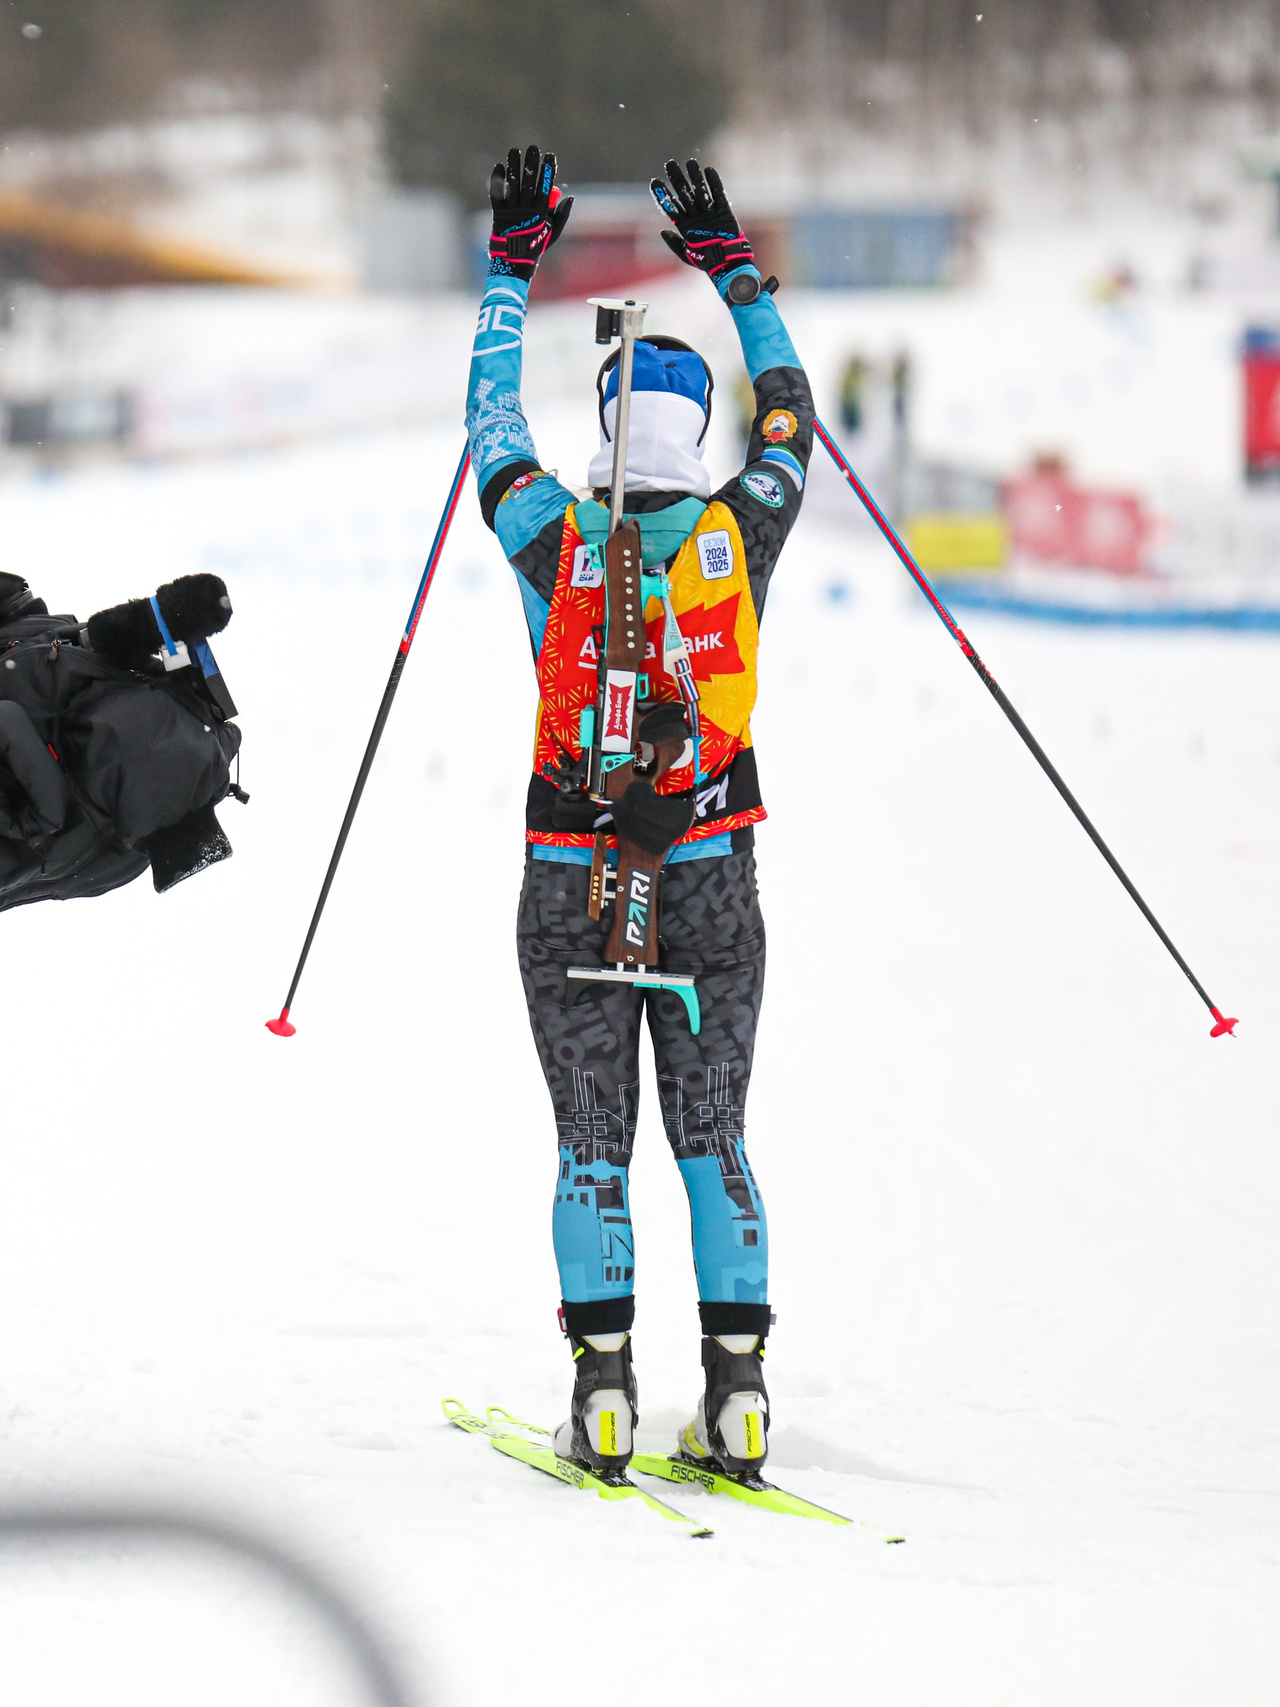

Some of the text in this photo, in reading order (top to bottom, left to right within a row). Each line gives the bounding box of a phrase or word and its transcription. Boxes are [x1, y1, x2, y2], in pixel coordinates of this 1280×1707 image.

[704, 536, 727, 549] СЕЗОН
[705, 546, 728, 560] 2024
[707, 559, 729, 573] 2025
[661, 631, 725, 656] анк
[625, 870, 651, 947] PARI
[744, 1413, 752, 1453] FISCHER
[555, 1460, 585, 1487] FISCHER
[670, 1464, 715, 1490] FISCHER
